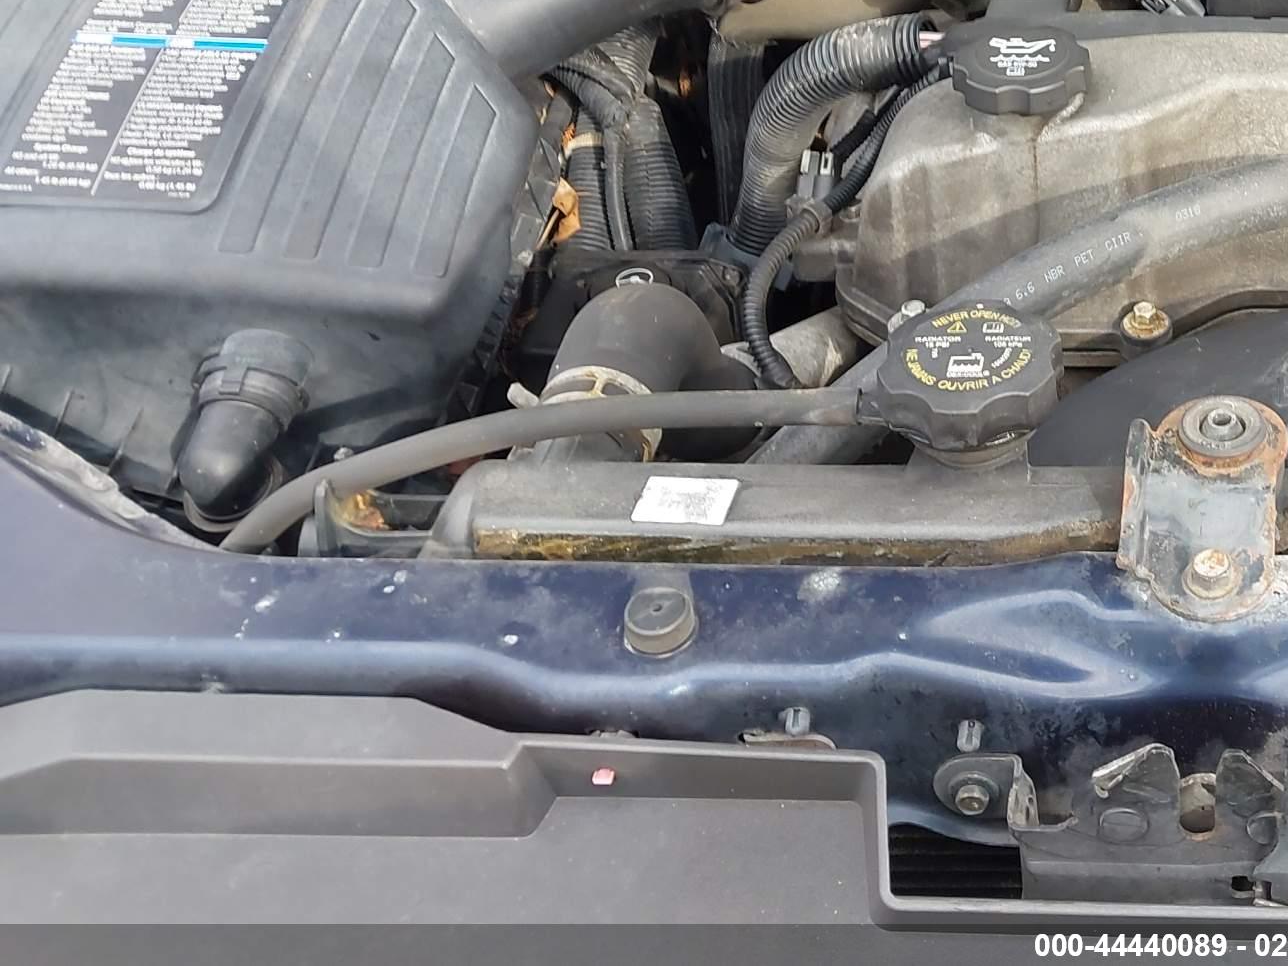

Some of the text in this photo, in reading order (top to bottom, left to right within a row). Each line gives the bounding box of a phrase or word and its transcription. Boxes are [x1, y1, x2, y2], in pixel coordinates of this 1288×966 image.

[1044, 265, 1066, 283] NBR
[1073, 248, 1094, 267] PET
[931, 310, 969, 328] NEVER
[970, 309, 1000, 321] OPEN
[937, 378, 989, 391] OUVRIR
